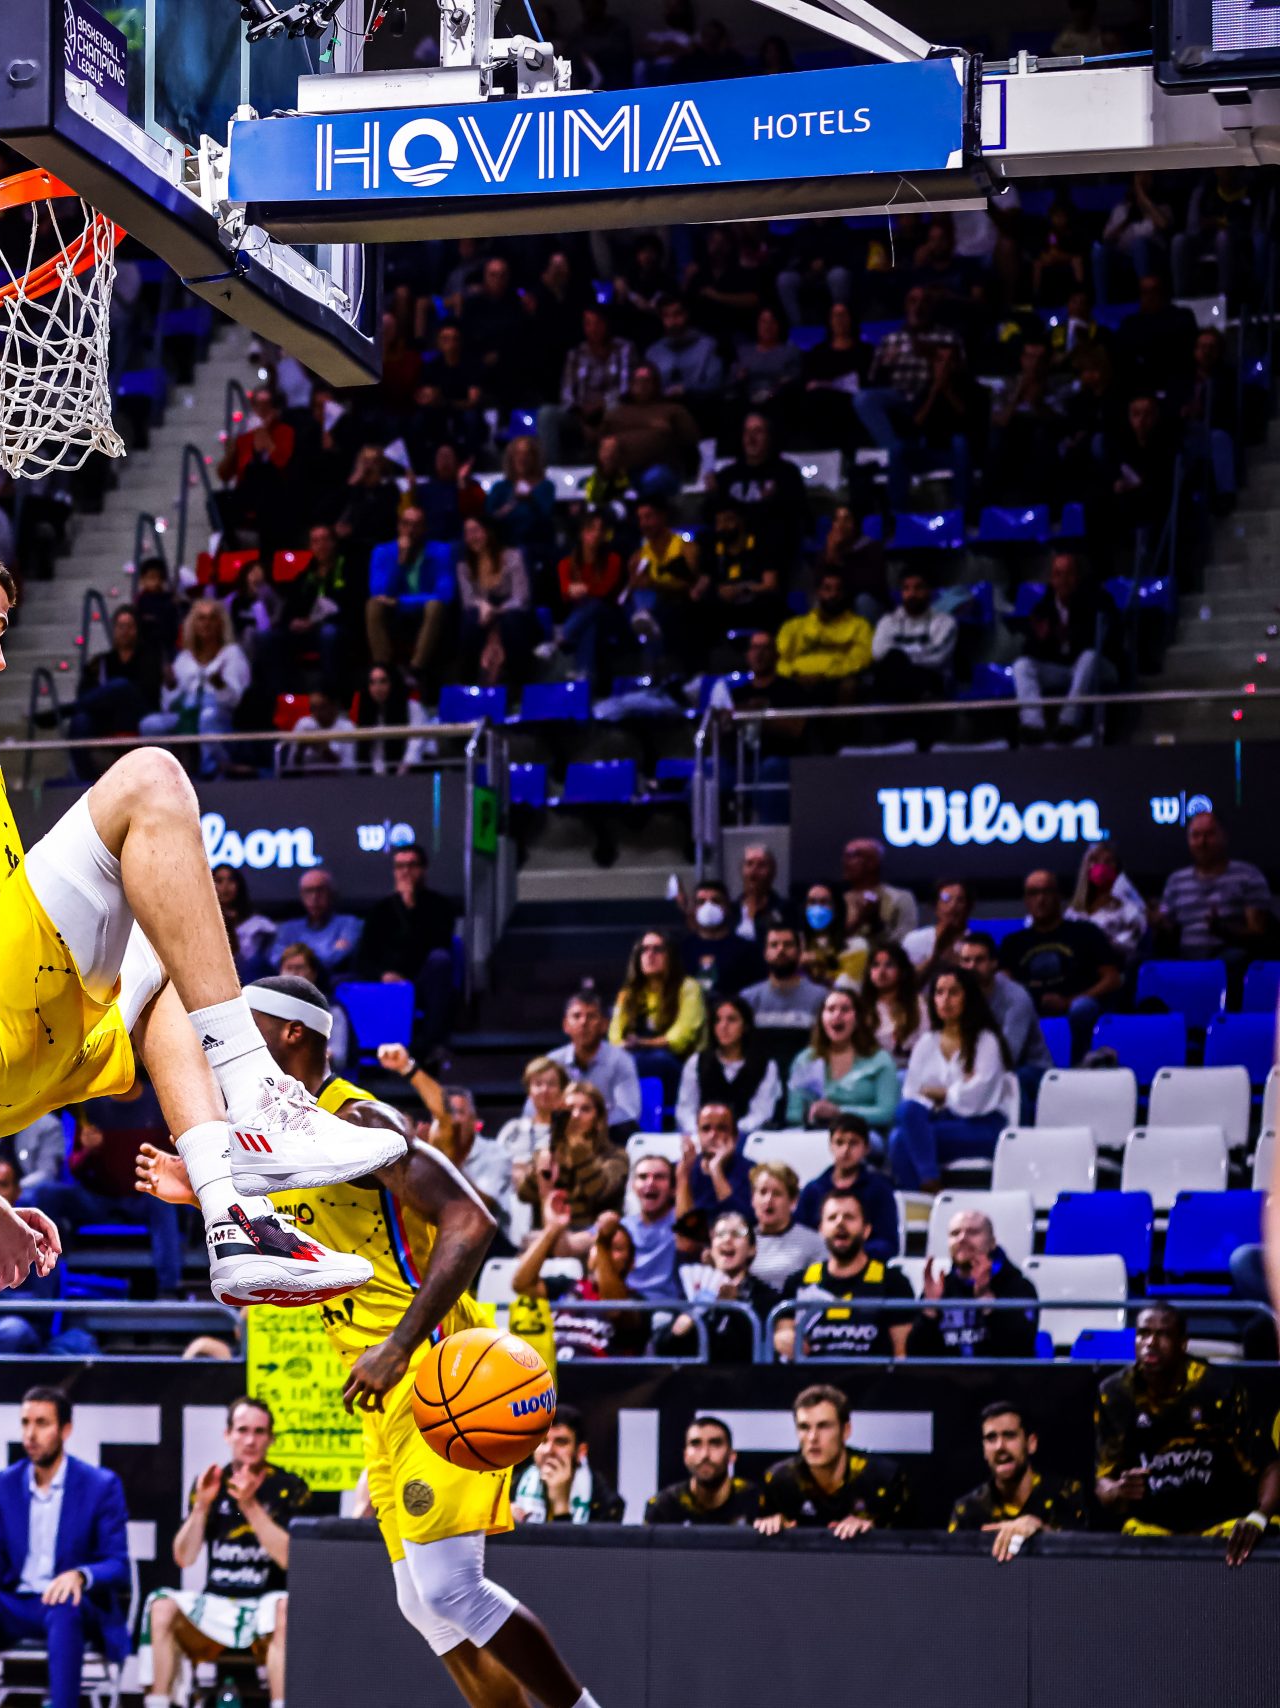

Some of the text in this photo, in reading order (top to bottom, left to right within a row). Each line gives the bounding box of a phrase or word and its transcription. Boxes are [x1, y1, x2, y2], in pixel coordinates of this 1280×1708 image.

[77, 16, 120, 63] BASKETBALL
[77, 34, 125, 87] CHAMPIONS
[77, 53, 104, 88] LEAGUE
[316, 100, 872, 191] HOVIMA HOTELS
[200, 813, 317, 869] lson
[877, 784, 1104, 847] Wilson
[207, 1228, 237, 1245] AME
